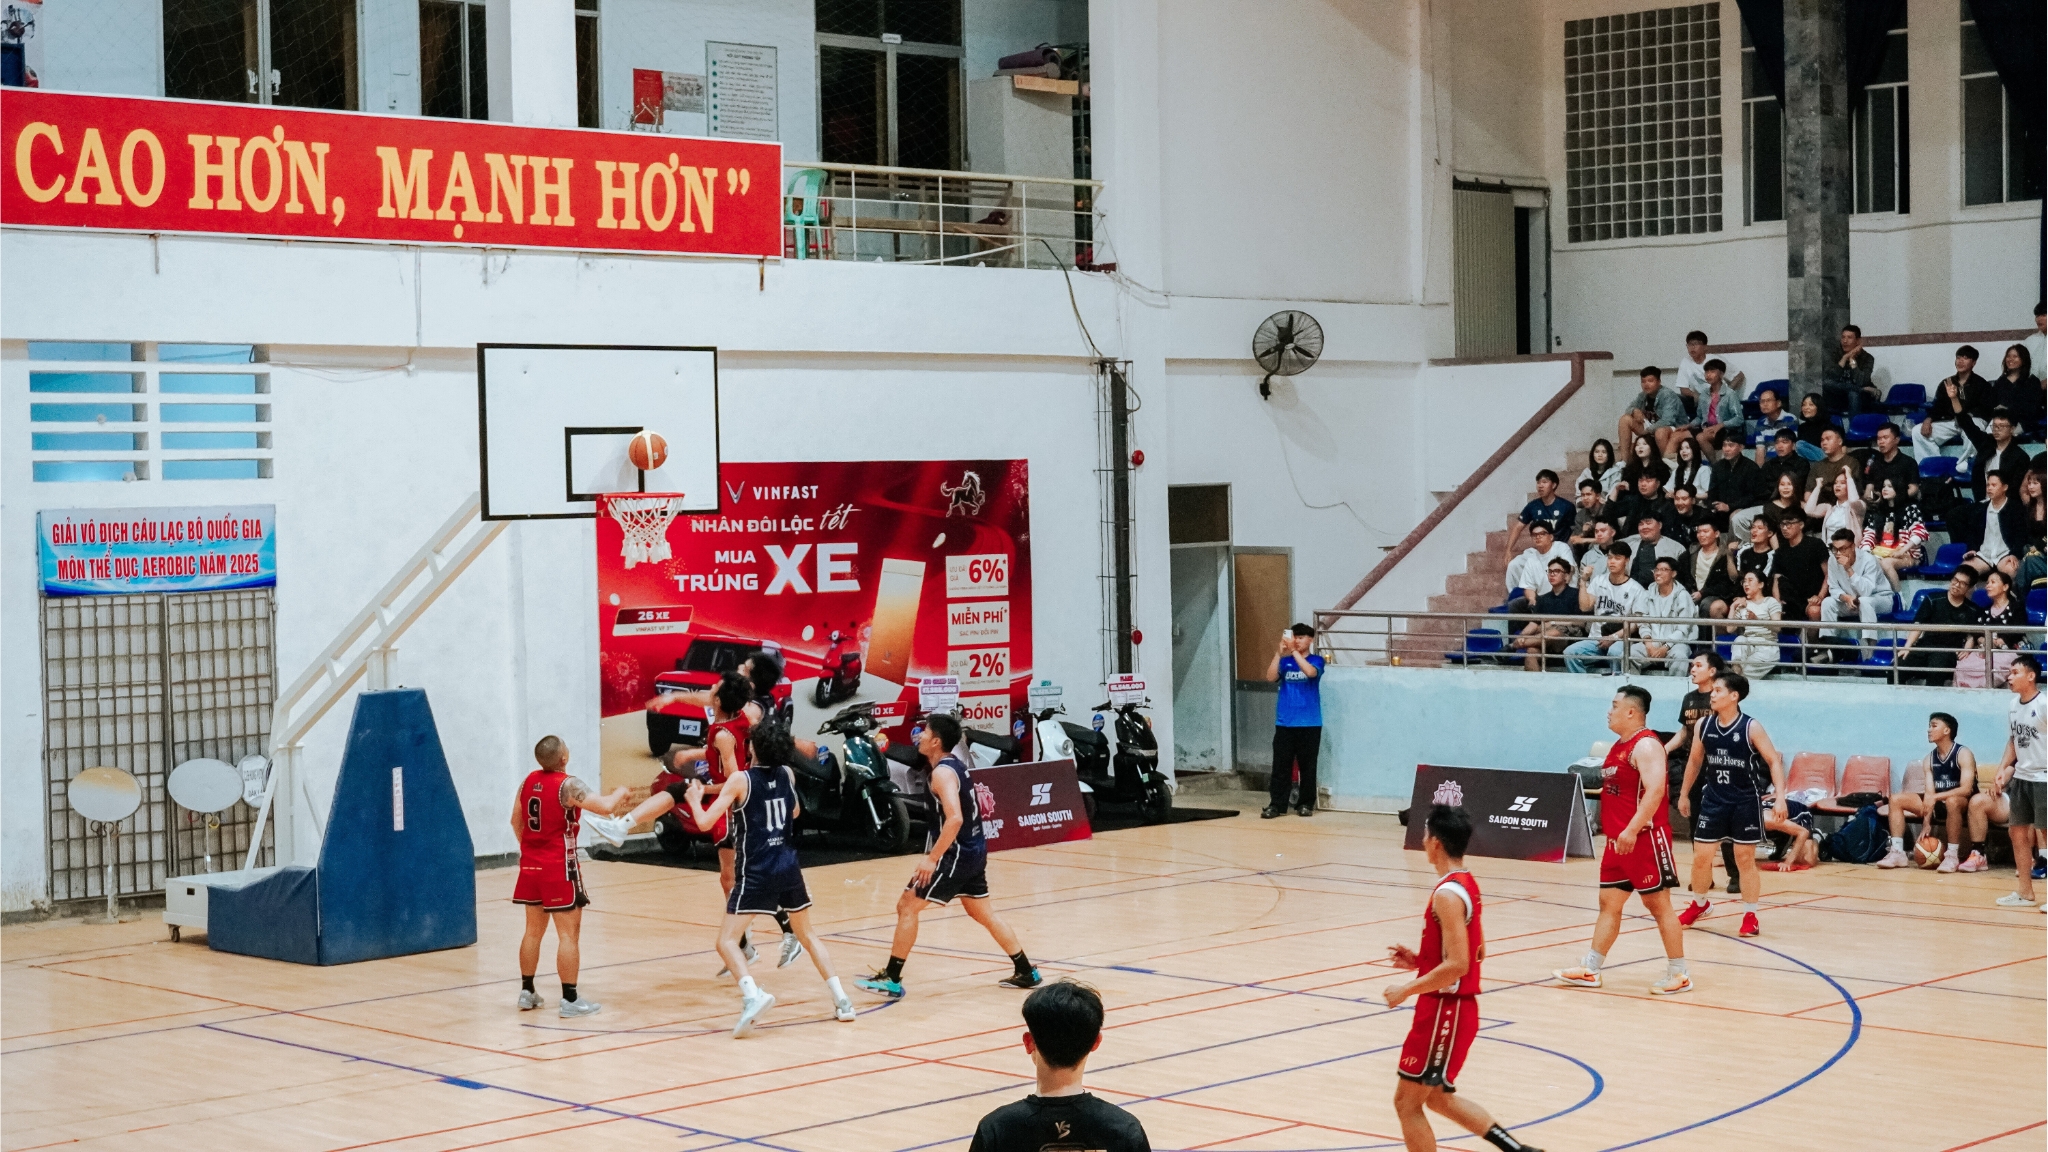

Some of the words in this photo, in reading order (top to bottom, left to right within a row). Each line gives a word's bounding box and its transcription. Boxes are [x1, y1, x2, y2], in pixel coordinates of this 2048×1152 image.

[15, 121, 167, 209] CAO
[187, 125, 345, 227] HƠN,
[376, 146, 575, 240] MẠNH
[752, 485, 819, 500] VINFAST
[52, 516, 77, 544] GIẢI
[81, 519, 96, 544] VÔ
[99, 523, 128, 548] ĐỊCH
[132, 518, 157, 543] CÂU
[160, 520, 183, 546] LẠC
[188, 516, 203, 545] BỘ
[207, 513, 238, 541] QUỐC
[242, 519, 262, 540] GIA
[691, 516, 743, 532] NHÂN
[747, 516, 777, 532] ĐÔI
[781, 515, 814, 535] LỘC
[819, 503, 863, 530] tết
[58, 555, 86, 580] MÔN
[89, 550, 111, 579] THỂ
[115, 556, 139, 583] DỤC
[142, 555, 196, 577] AEROBIC
[200, 551, 227, 575] NĂM
[230, 553, 259, 574] 2025
[715, 551, 756, 563] MUA
[764, 543, 861, 596] XE
[674, 569, 758, 591] TRÚNG
[638, 611, 654, 620] 26
[656, 611, 670, 620] XE
[952, 607, 980, 625] MIỄN
[882, 706, 894, 714] XE
[1716, 770, 1730, 784] 25
[528, 796, 541, 832] 9
[764, 798, 787, 832] 10
[1018, 812, 1046, 827] SAIGON
[1047, 810, 1073, 824] SOUTH
[1488, 814, 1520, 826] SAIGON
[1520, 818, 1548, 828] SOUTH
[1656, 830, 1670, 871] AMIGOS
[1434, 1020, 1450, 1067] AMIGOS
